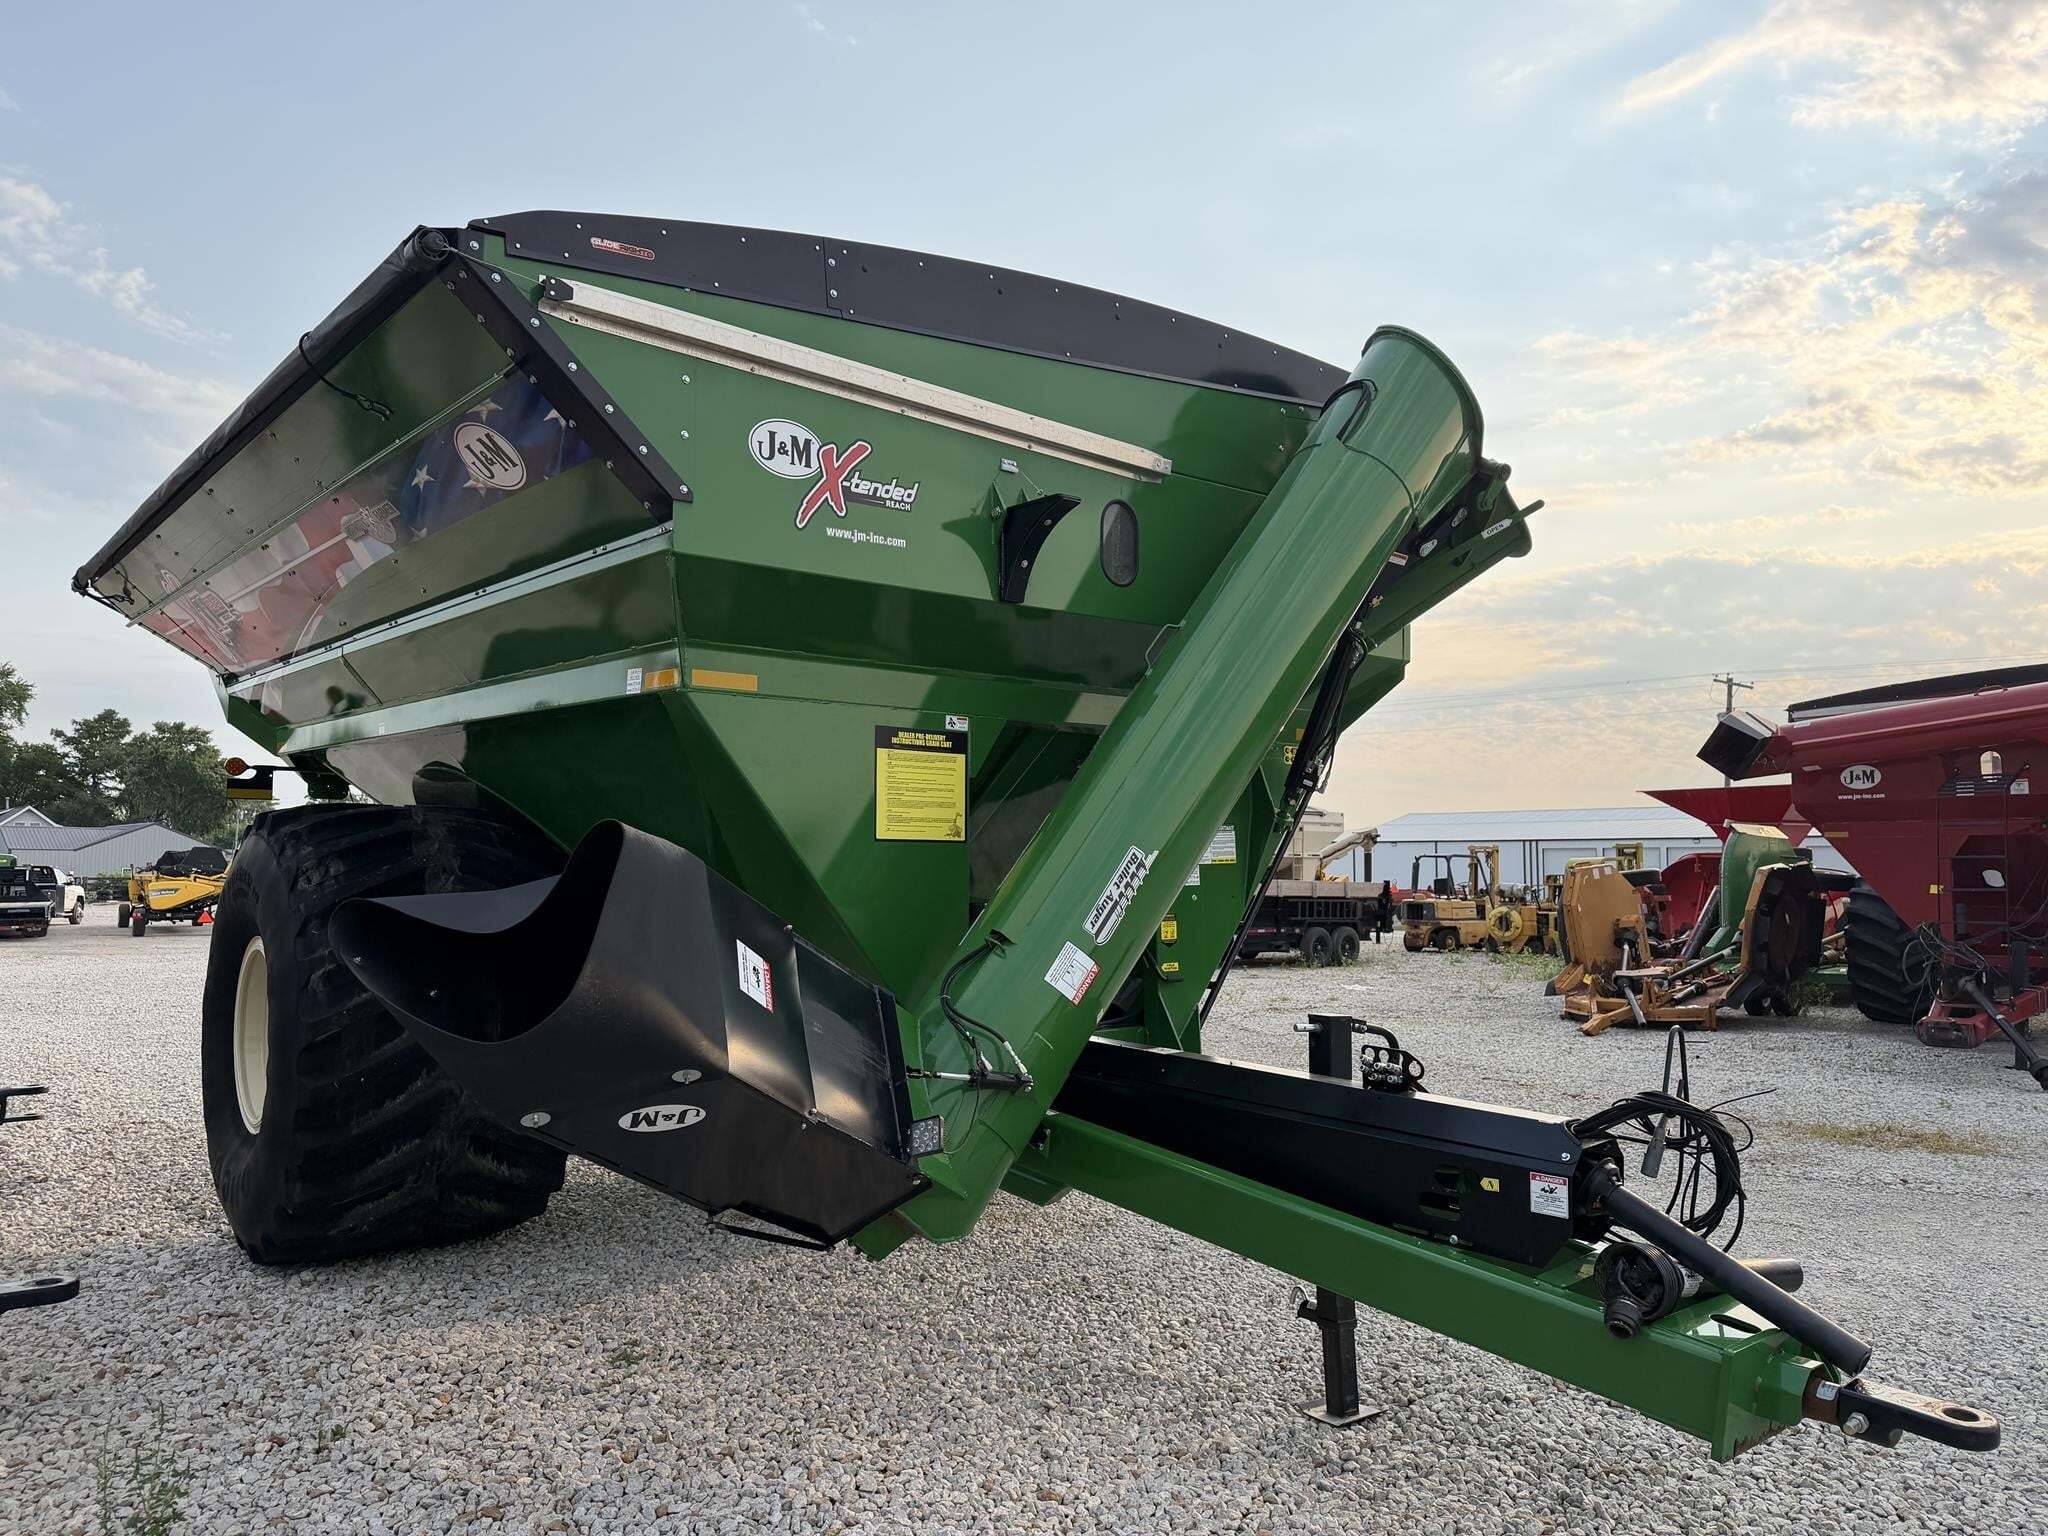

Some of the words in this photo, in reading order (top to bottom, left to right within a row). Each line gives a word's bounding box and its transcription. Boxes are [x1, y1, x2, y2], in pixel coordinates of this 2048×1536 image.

[464, 433, 518, 480] J&M
[757, 430, 812, 470] J&M
[885, 500, 911, 511] REACH
[826, 526, 906, 548] www.jm-inc.com
[1487, 523, 1504, 535] OPEN
[1843, 769, 1875, 785] J&M
[1112, 852, 1140, 890] Bullet
[1089, 889, 1114, 930] Auger
[1072, 970, 1095, 1005] DANGER
[629, 1108, 701, 1129] J&M
